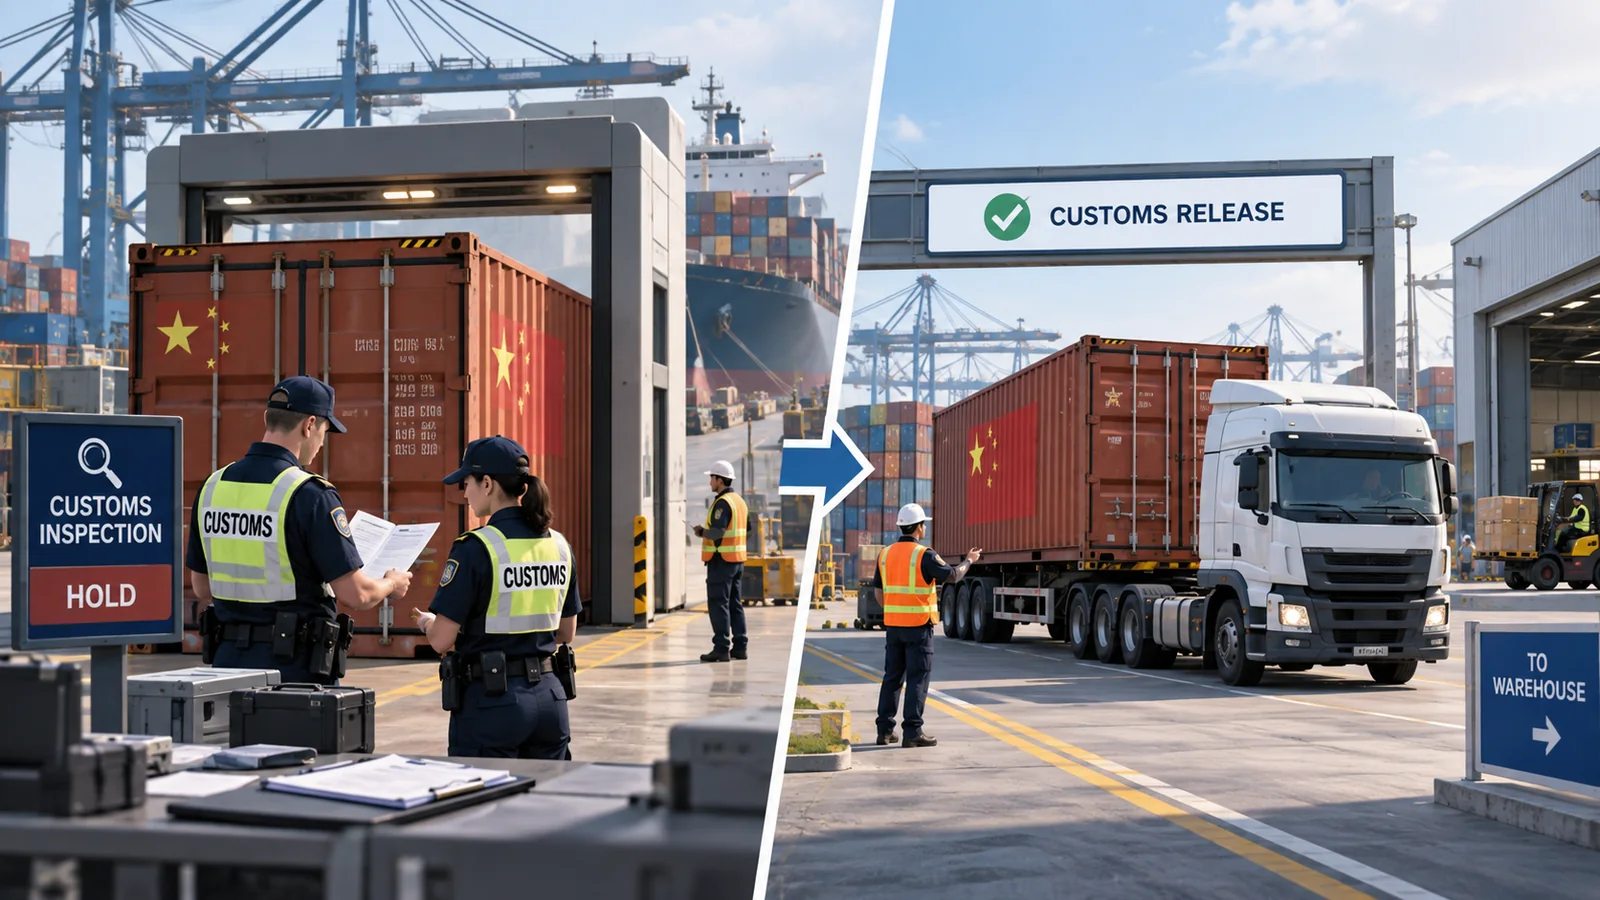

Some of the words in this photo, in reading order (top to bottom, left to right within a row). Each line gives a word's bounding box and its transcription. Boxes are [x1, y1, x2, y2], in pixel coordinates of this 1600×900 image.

[1049, 204, 1168, 227] CUSTOMS
[1177, 201, 1285, 224] RELEASE
[49, 495, 153, 517] CUSTOMS
[39, 523, 162, 545] INSPECTION
[203, 510, 273, 538] CUSTOMS
[503, 564, 567, 588] CUSTOMS
[66, 583, 137, 609] HOLD
[1527, 652, 1548, 673] TO
[1492, 676, 1587, 703] WAREHOUSE
